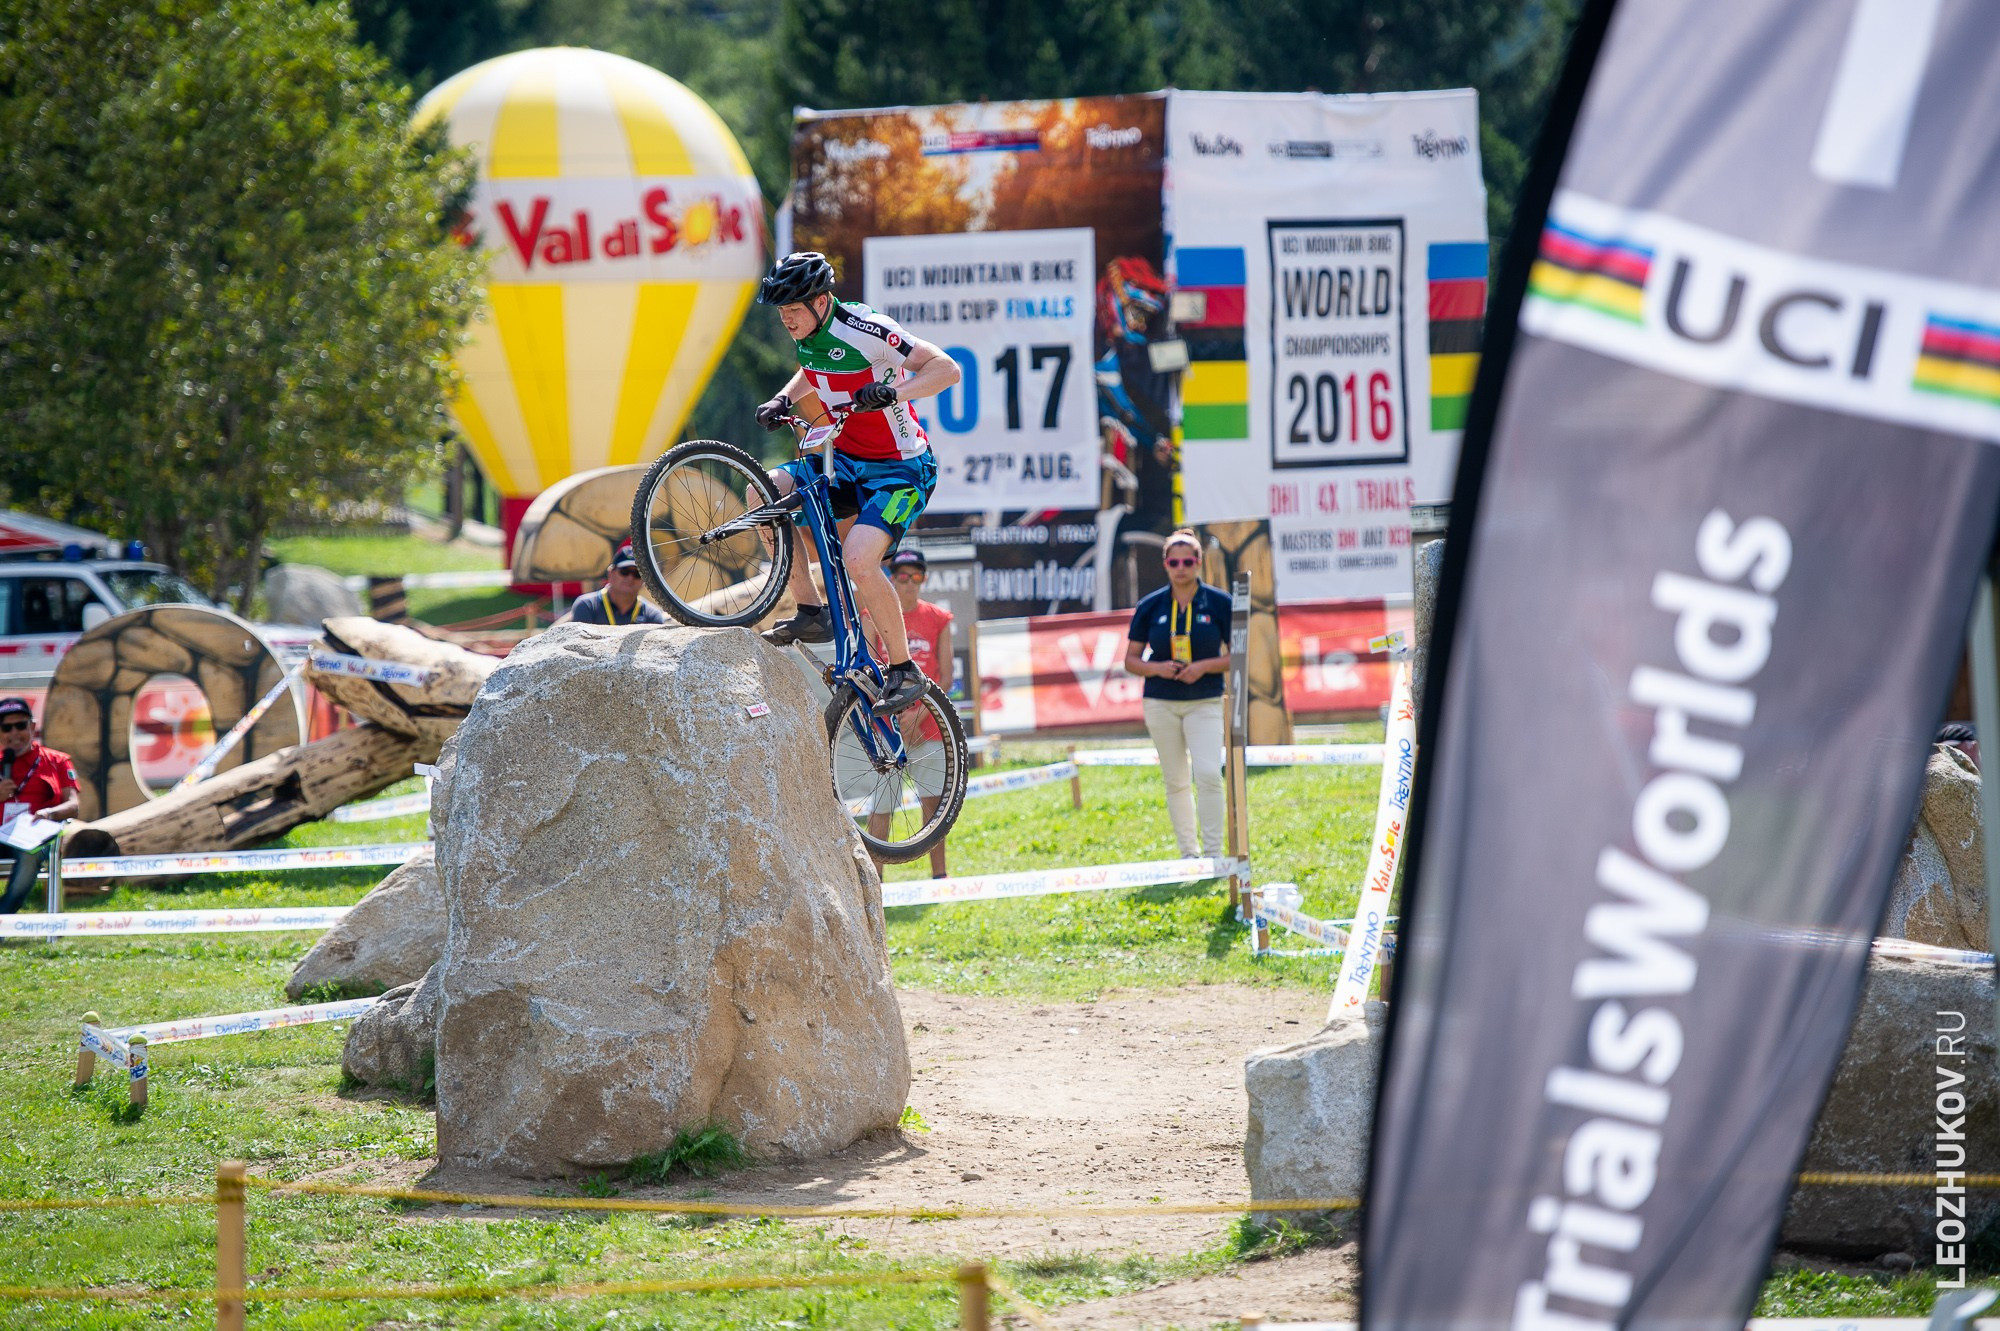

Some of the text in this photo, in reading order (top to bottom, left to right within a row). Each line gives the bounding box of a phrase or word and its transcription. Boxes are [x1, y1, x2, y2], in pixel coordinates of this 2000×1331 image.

[498, 197, 590, 271] Val
[604, 219, 639, 257] di
[1306, 233, 1362, 253] MOUNTAIN
[883, 259, 1076, 288] UCI MOUNTAIN BIKE
[1283, 267, 1391, 317] WORLD
[846, 316, 882, 336] ŠKODA
[884, 296, 1075, 323] WORLD CUP FINALS
[1664, 257, 1887, 380] UCI
[1285, 333, 1390, 357] CHAMPIONSHIPS
[911, 344, 1075, 434] 017
[1289, 371, 1393, 443] 2016
[892, 402, 909, 439] doise
[1021, 452, 1081, 481] AUG.
[1355, 477, 1416, 512] TRIALS
[973, 559, 1099, 606] leworldcup
[1057, 631, 1144, 711] Va
[1389, 738, 1413, 811] TRENTINO
[1381, 820, 1401, 860] Sole
[1371, 869, 1391, 894] Val
[1384, 859, 1393, 872] di
[1349, 911, 1380, 986] TRENTINO
